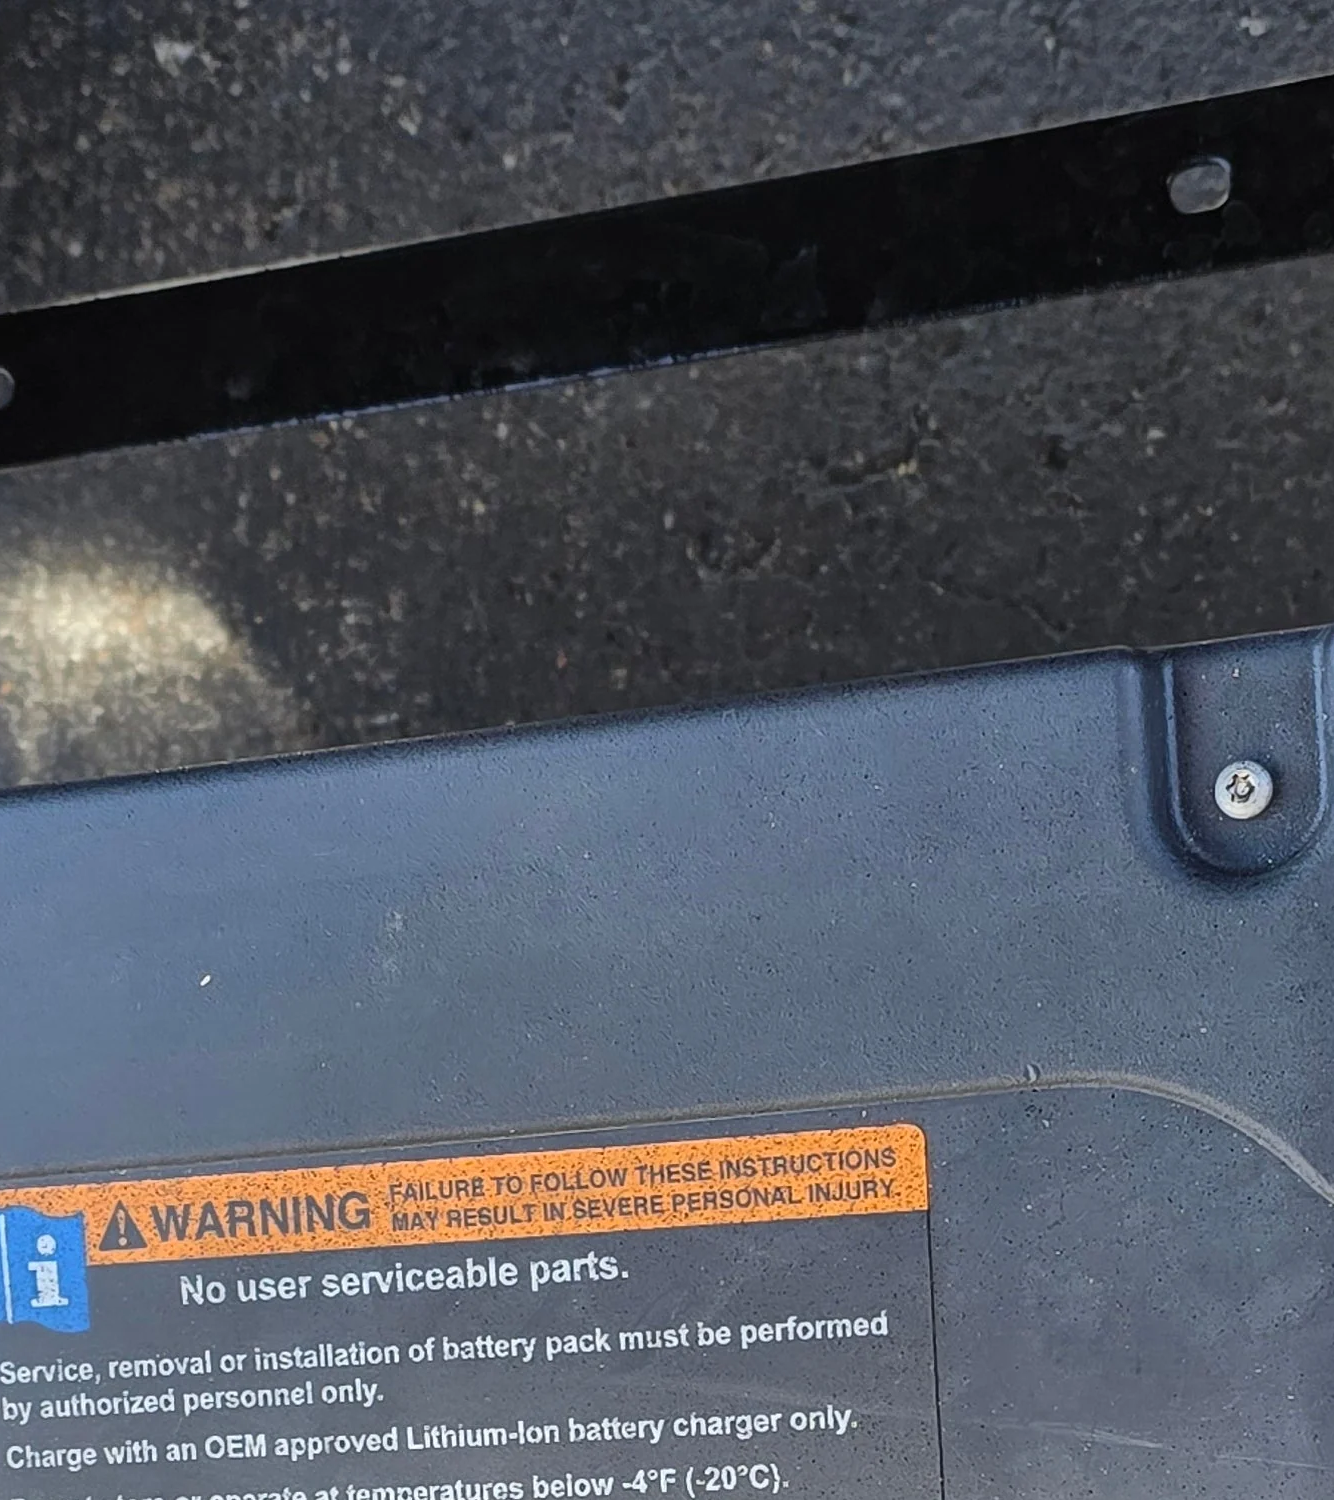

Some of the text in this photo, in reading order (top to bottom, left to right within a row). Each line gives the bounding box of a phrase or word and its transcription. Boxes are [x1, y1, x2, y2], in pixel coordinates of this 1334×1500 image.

[388, 1146, 897, 1203] FAILURE TO FOLLOW THESE INSTRUCTIONS
[148, 1189, 372, 1244] WARNING
[391, 1207, 440, 1232] MAY
[446, 1201, 536, 1228] RESULT
[542, 1199, 565, 1222] IN
[572, 1193, 663, 1220] SEVERE
[671, 1183, 799, 1214] PERSONAL
[179, 1249, 630, 1306] No user serviceable parts.
[107, 1349, 212, 1379] removal
[219, 1352, 248, 1373] or
[254, 1339, 400, 1371] installation
[407, 1337, 436, 1363] of
[441, 1331, 537, 1366] battery
[544, 1327, 611, 1361] pack
[617, 1324, 690, 1351] must
[696, 1320, 732, 1347] be
[739, 1310, 888, 1349] performed
[1, 1377, 385, 1425] by authorized personnel only.
[4, 1440, 98, 1474] Charge
[103, 1437, 157, 1465] with
[164, 1441, 197, 1462] an
[204, 1432, 267, 1460] OEM
[273, 1425, 398, 1462] approved
[567, 1412, 665, 1447] battery
[671, 1406, 782, 1442] charger
[788, 1403, 859, 1437] only.
[531, 1471, 614, 1499] below
[620, 1468, 677, 1495] -4°F
[684, 1462, 790, 1499] (-20°C).
